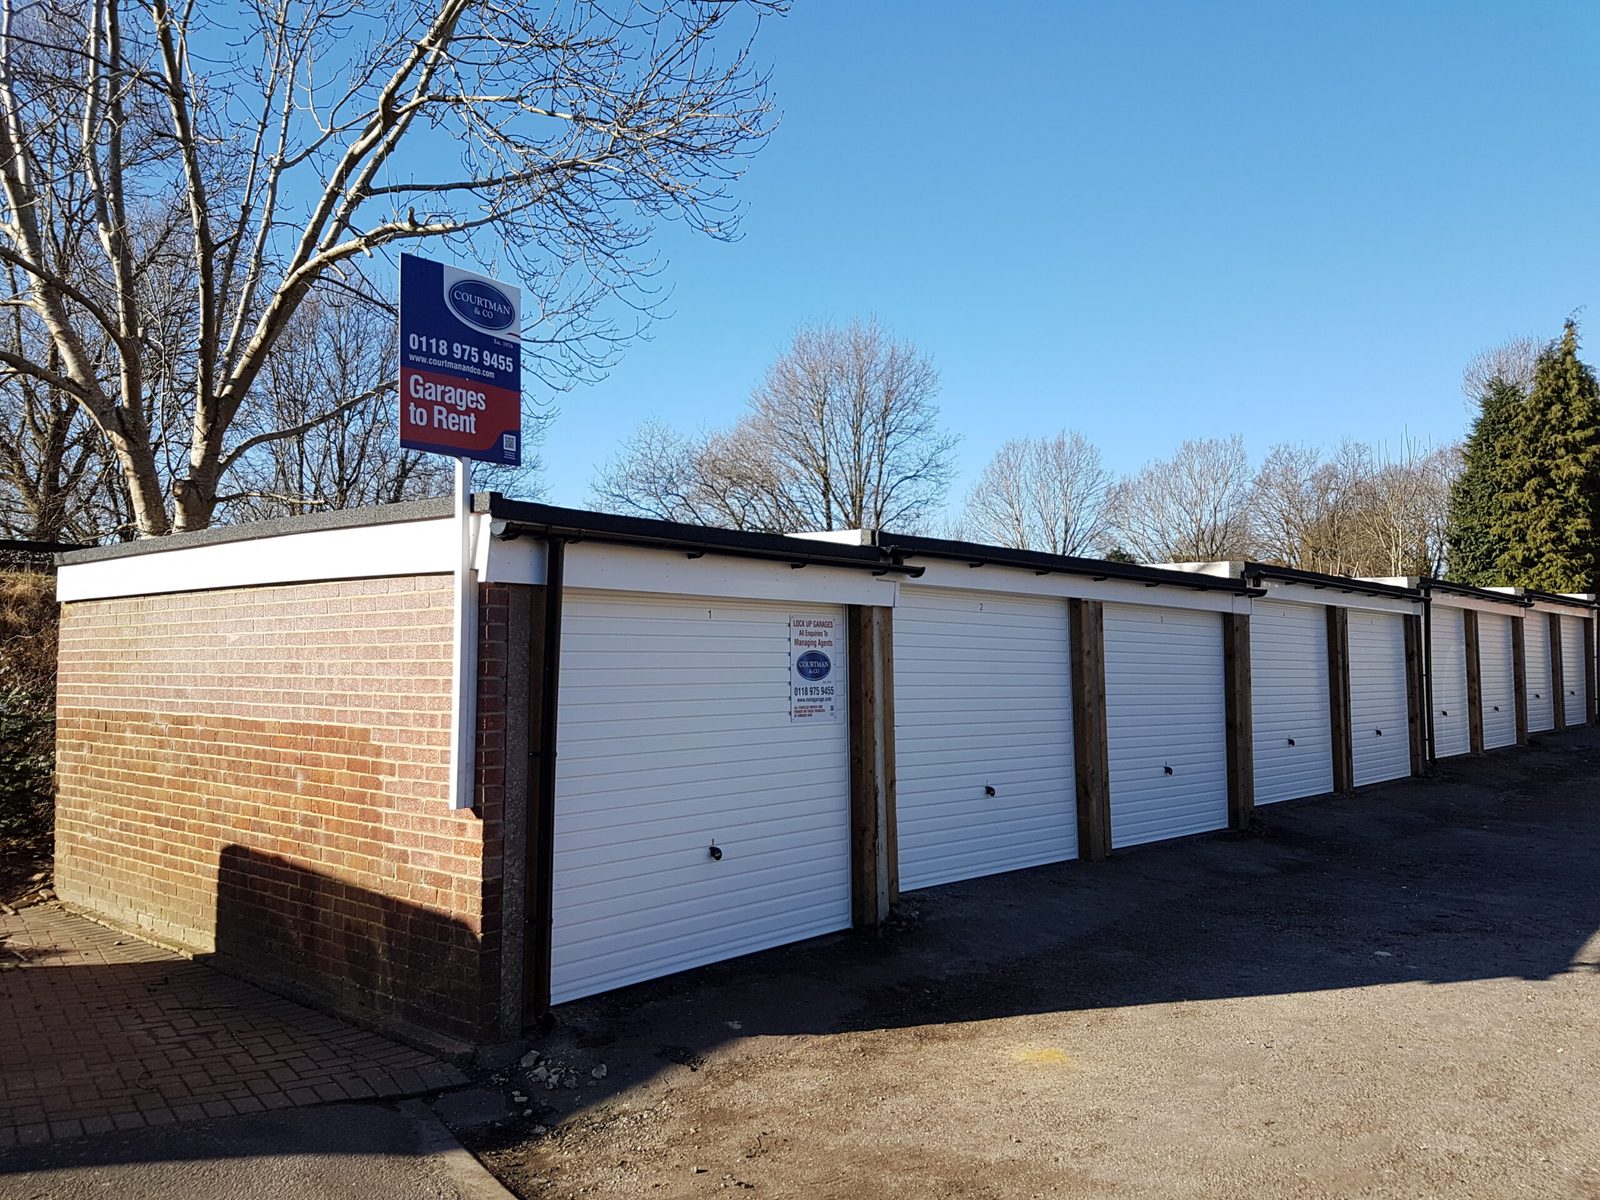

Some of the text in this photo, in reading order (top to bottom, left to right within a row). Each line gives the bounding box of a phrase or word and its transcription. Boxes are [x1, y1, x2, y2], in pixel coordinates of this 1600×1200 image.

[454, 290, 511, 316] COURTMAN
[474, 307, 494, 319] & CO
[408, 353, 495, 379] www.courtmanandco.com
[409, 333, 514, 373] 0118 975 9455
[409, 374, 486, 411] Garages
[408, 402, 477, 434] to Rent
[793, 619, 833, 628] LOCK UP GARAGES
[794, 638, 833, 648] Managing Agents
[794, 686, 835, 696] 0118 975 9455
